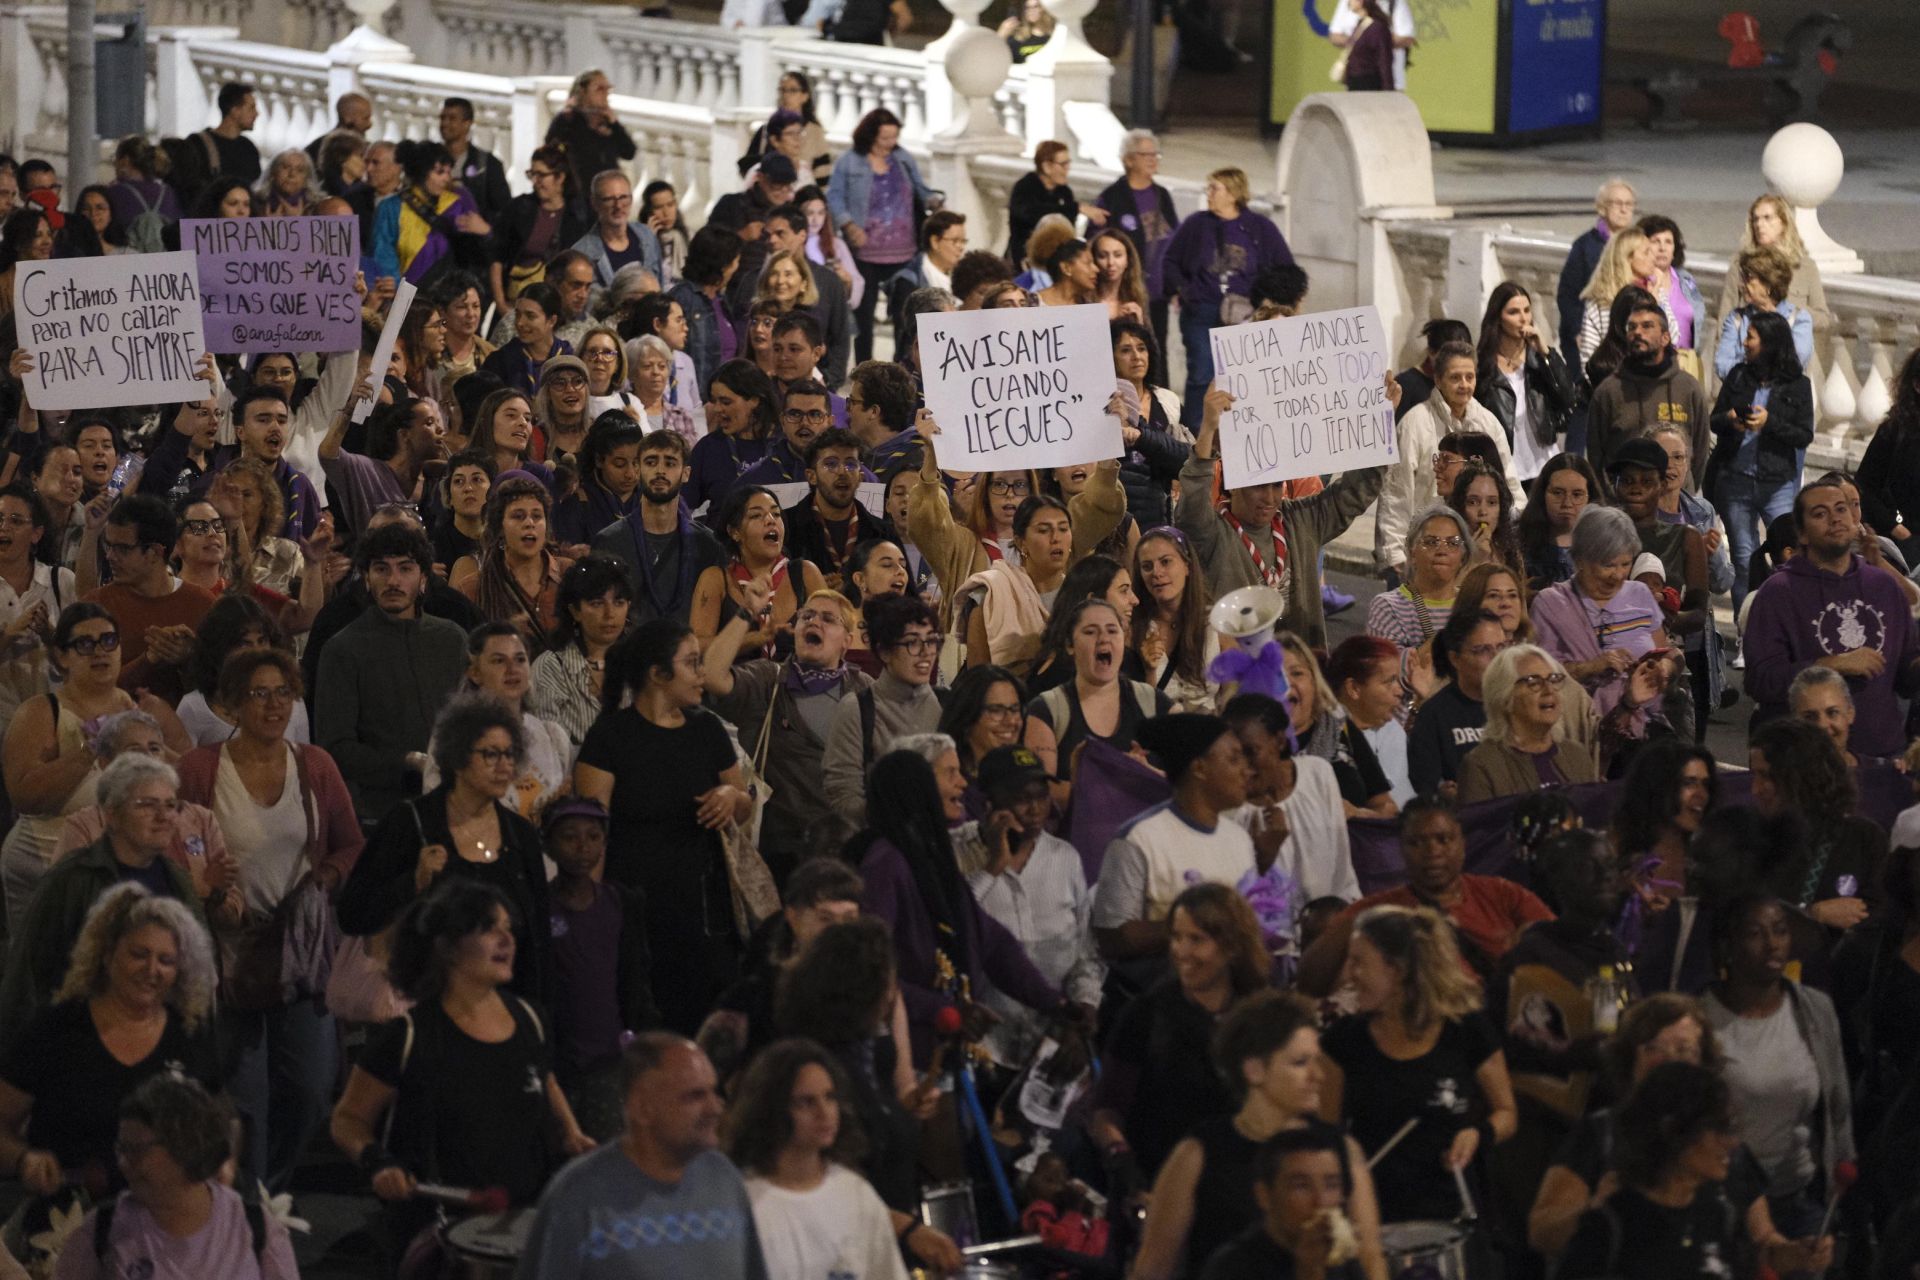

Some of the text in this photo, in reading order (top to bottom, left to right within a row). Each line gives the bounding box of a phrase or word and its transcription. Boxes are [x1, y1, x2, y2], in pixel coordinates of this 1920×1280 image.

[310, 219, 352, 257] BIEN
[23, 270, 196, 317] Gritamos AHORA
[224, 261, 294, 284] SOMOS
[32, 305, 182, 344] para NO callar
[227, 292, 264, 314] LAS
[270, 292, 309, 315] QUE
[316, 294, 356, 324] VES
[39, 331, 204, 389] PARA SIEMPRE
[1214, 315, 1369, 375] ¡LUCHA AUNQUE
[971, 368, 1068, 409] CUANDO
[1228, 373, 1249, 400] LO
[1259, 356, 1328, 396] TENGAS
[964, 394, 1083, 454] LLEGUES”
[1232, 386, 1385, 432] POR TODAS LAS QUE
[1245, 409, 1393, 472] NO LO TIENEN!
